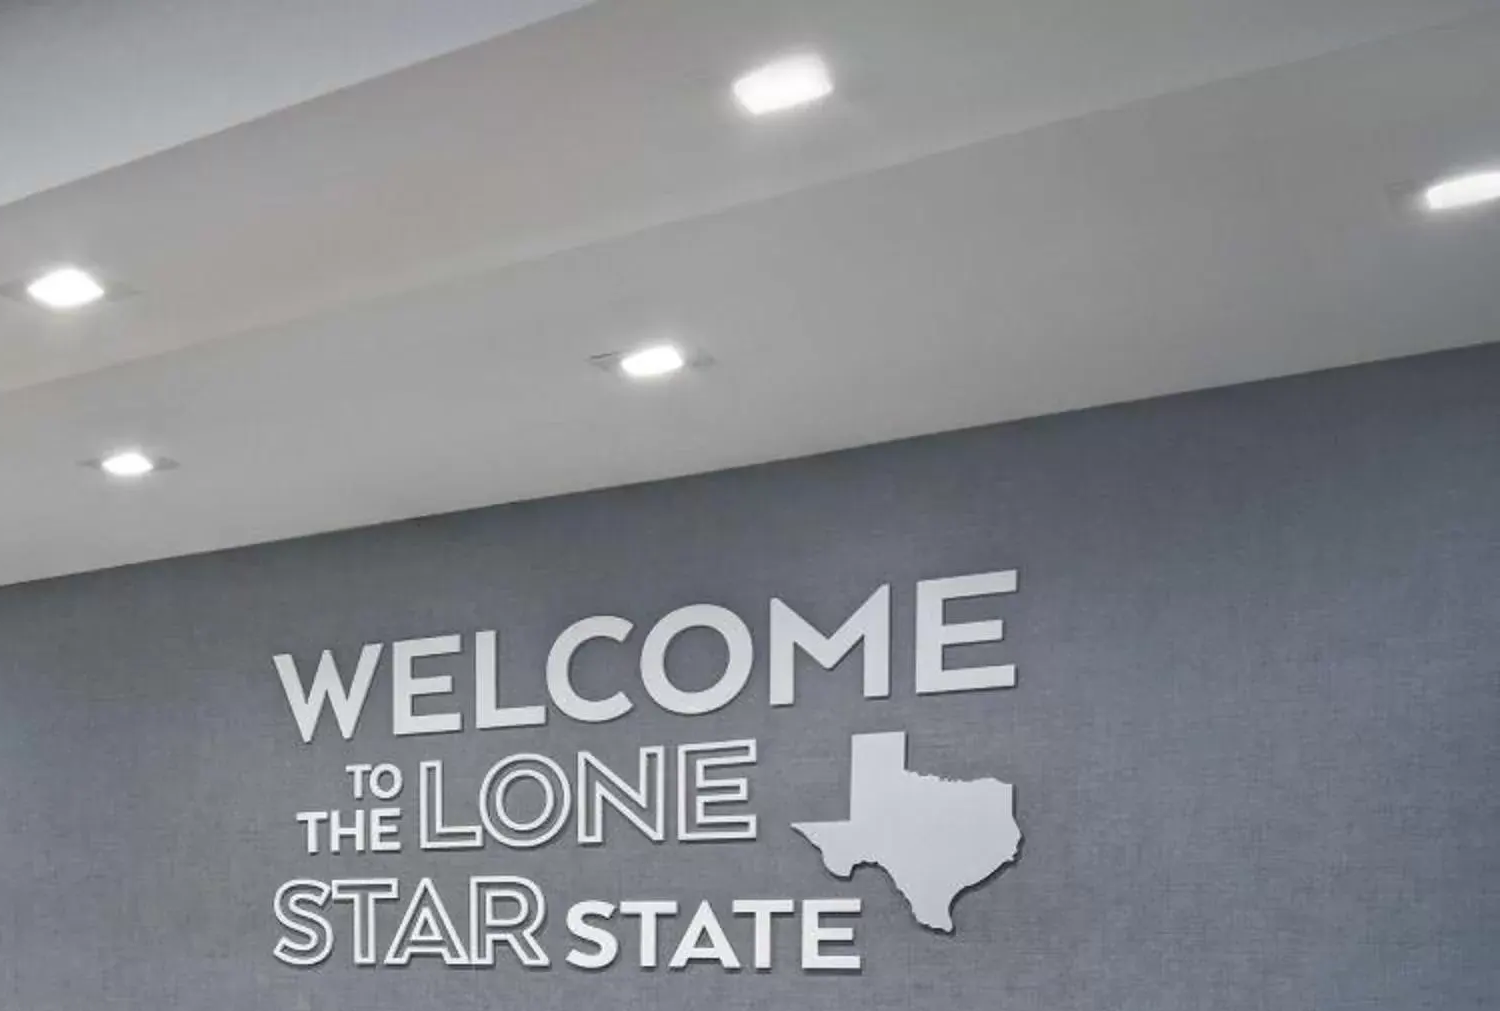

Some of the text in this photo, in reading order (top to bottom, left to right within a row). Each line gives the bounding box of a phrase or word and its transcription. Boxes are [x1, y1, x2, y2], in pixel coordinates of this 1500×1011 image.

[272, 569, 1019, 743] WELCOME
[296, 738, 759, 855] THE LONE
[346, 763, 404, 801] TO
[273, 875, 863, 972] STAR STATE
